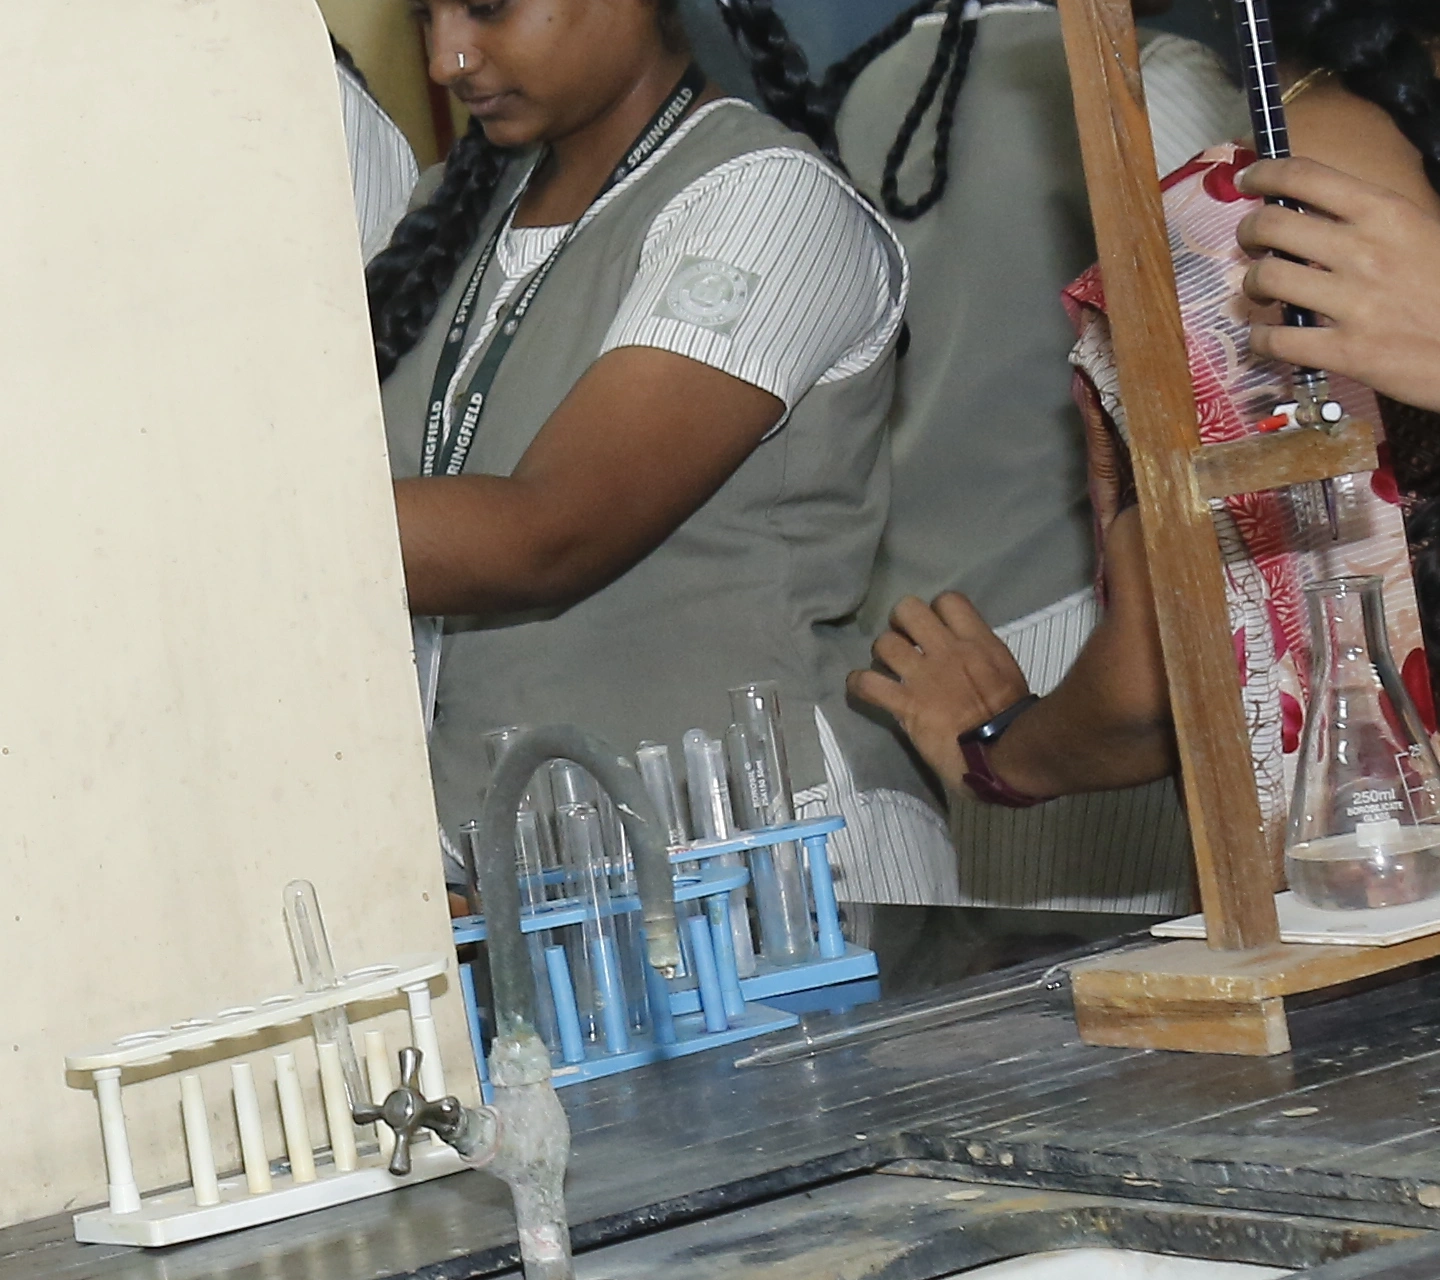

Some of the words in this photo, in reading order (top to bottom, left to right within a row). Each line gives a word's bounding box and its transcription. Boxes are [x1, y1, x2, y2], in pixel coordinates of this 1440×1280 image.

[627, 86, 694, 167] SPRINGFIELD
[1352, 788, 1397, 805] 250ml
[1346, 800, 1405, 817] BOROSILICATE
